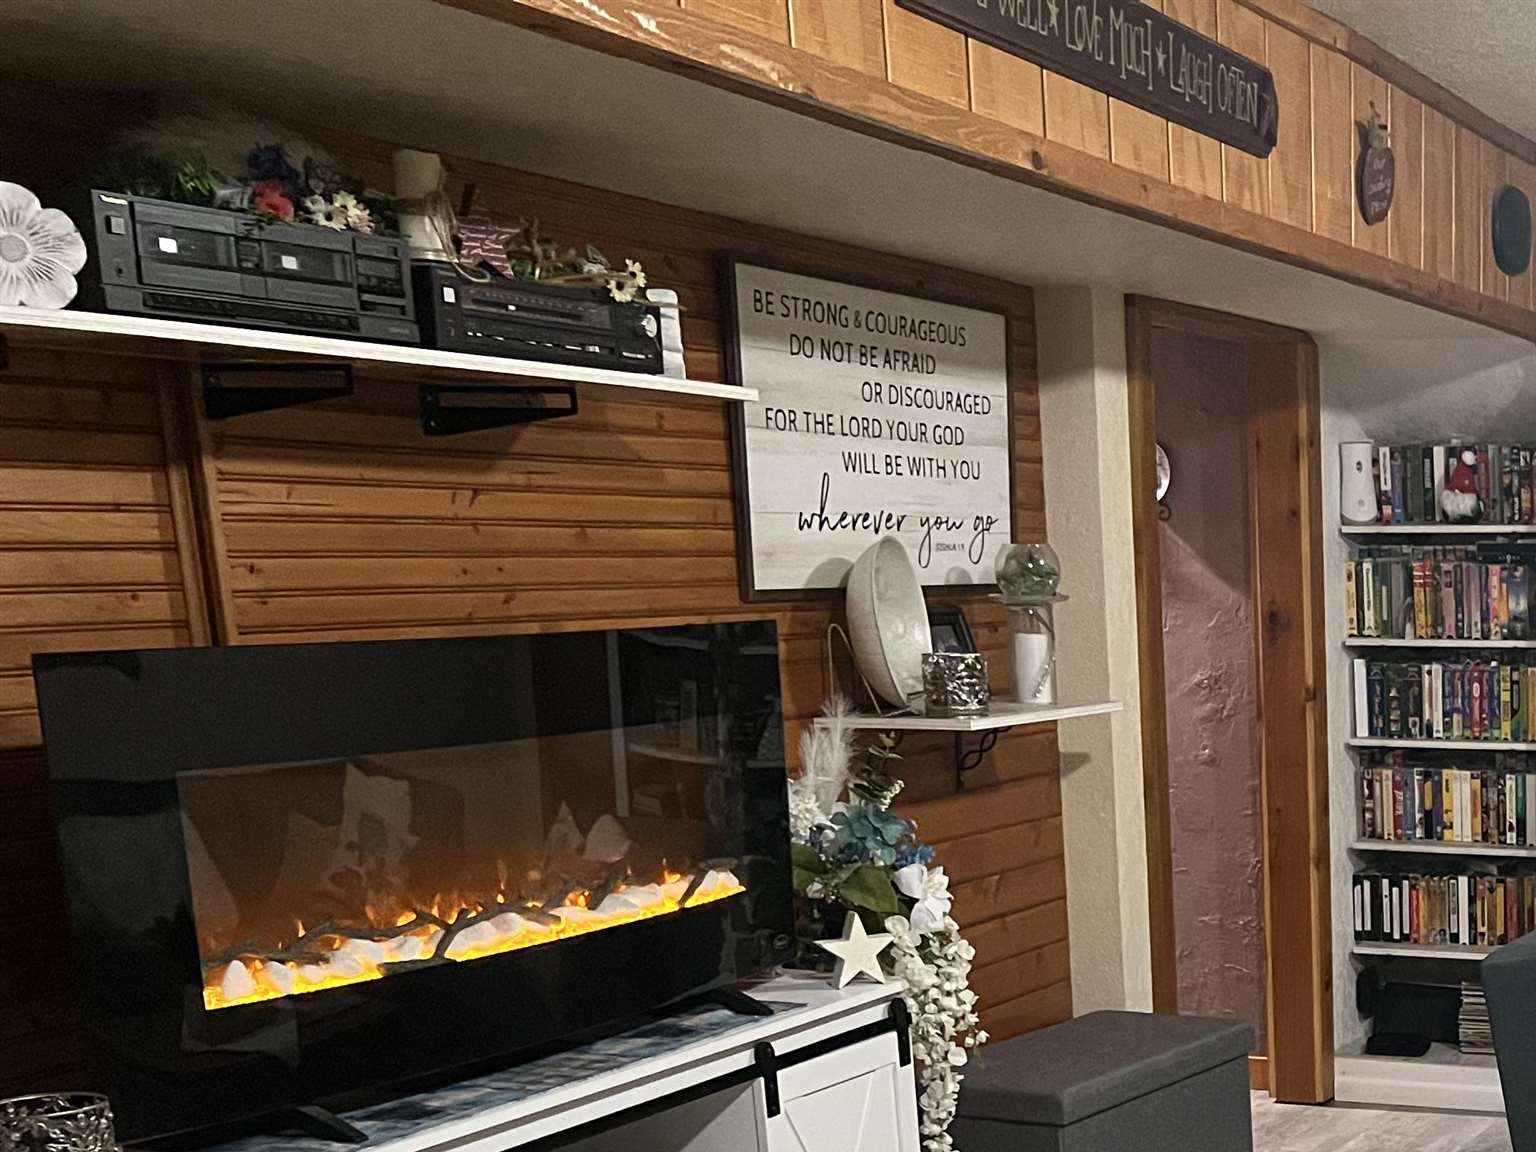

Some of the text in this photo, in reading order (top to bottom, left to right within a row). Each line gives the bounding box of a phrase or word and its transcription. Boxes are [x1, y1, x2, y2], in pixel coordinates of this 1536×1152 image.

[1065, 0, 1103, 61] LOVE
[1109, 5, 1153, 91] MUCH
[1167, 31, 1214, 114] LAUGH
[1216, 63, 1259, 128] OFTEN
[753, 288, 967, 347] BE STRONG & COURAGEOUS
[789, 333, 936, 375] DO NOT BE AFRAID
[861, 381, 992, 415] OR DISCOURAGED
[765, 407, 964, 446] FOR THE LORD YOUR GOD
[842, 451, 981, 481] WILL BE WITH YOU
[798, 472, 999, 569] wherever you go
